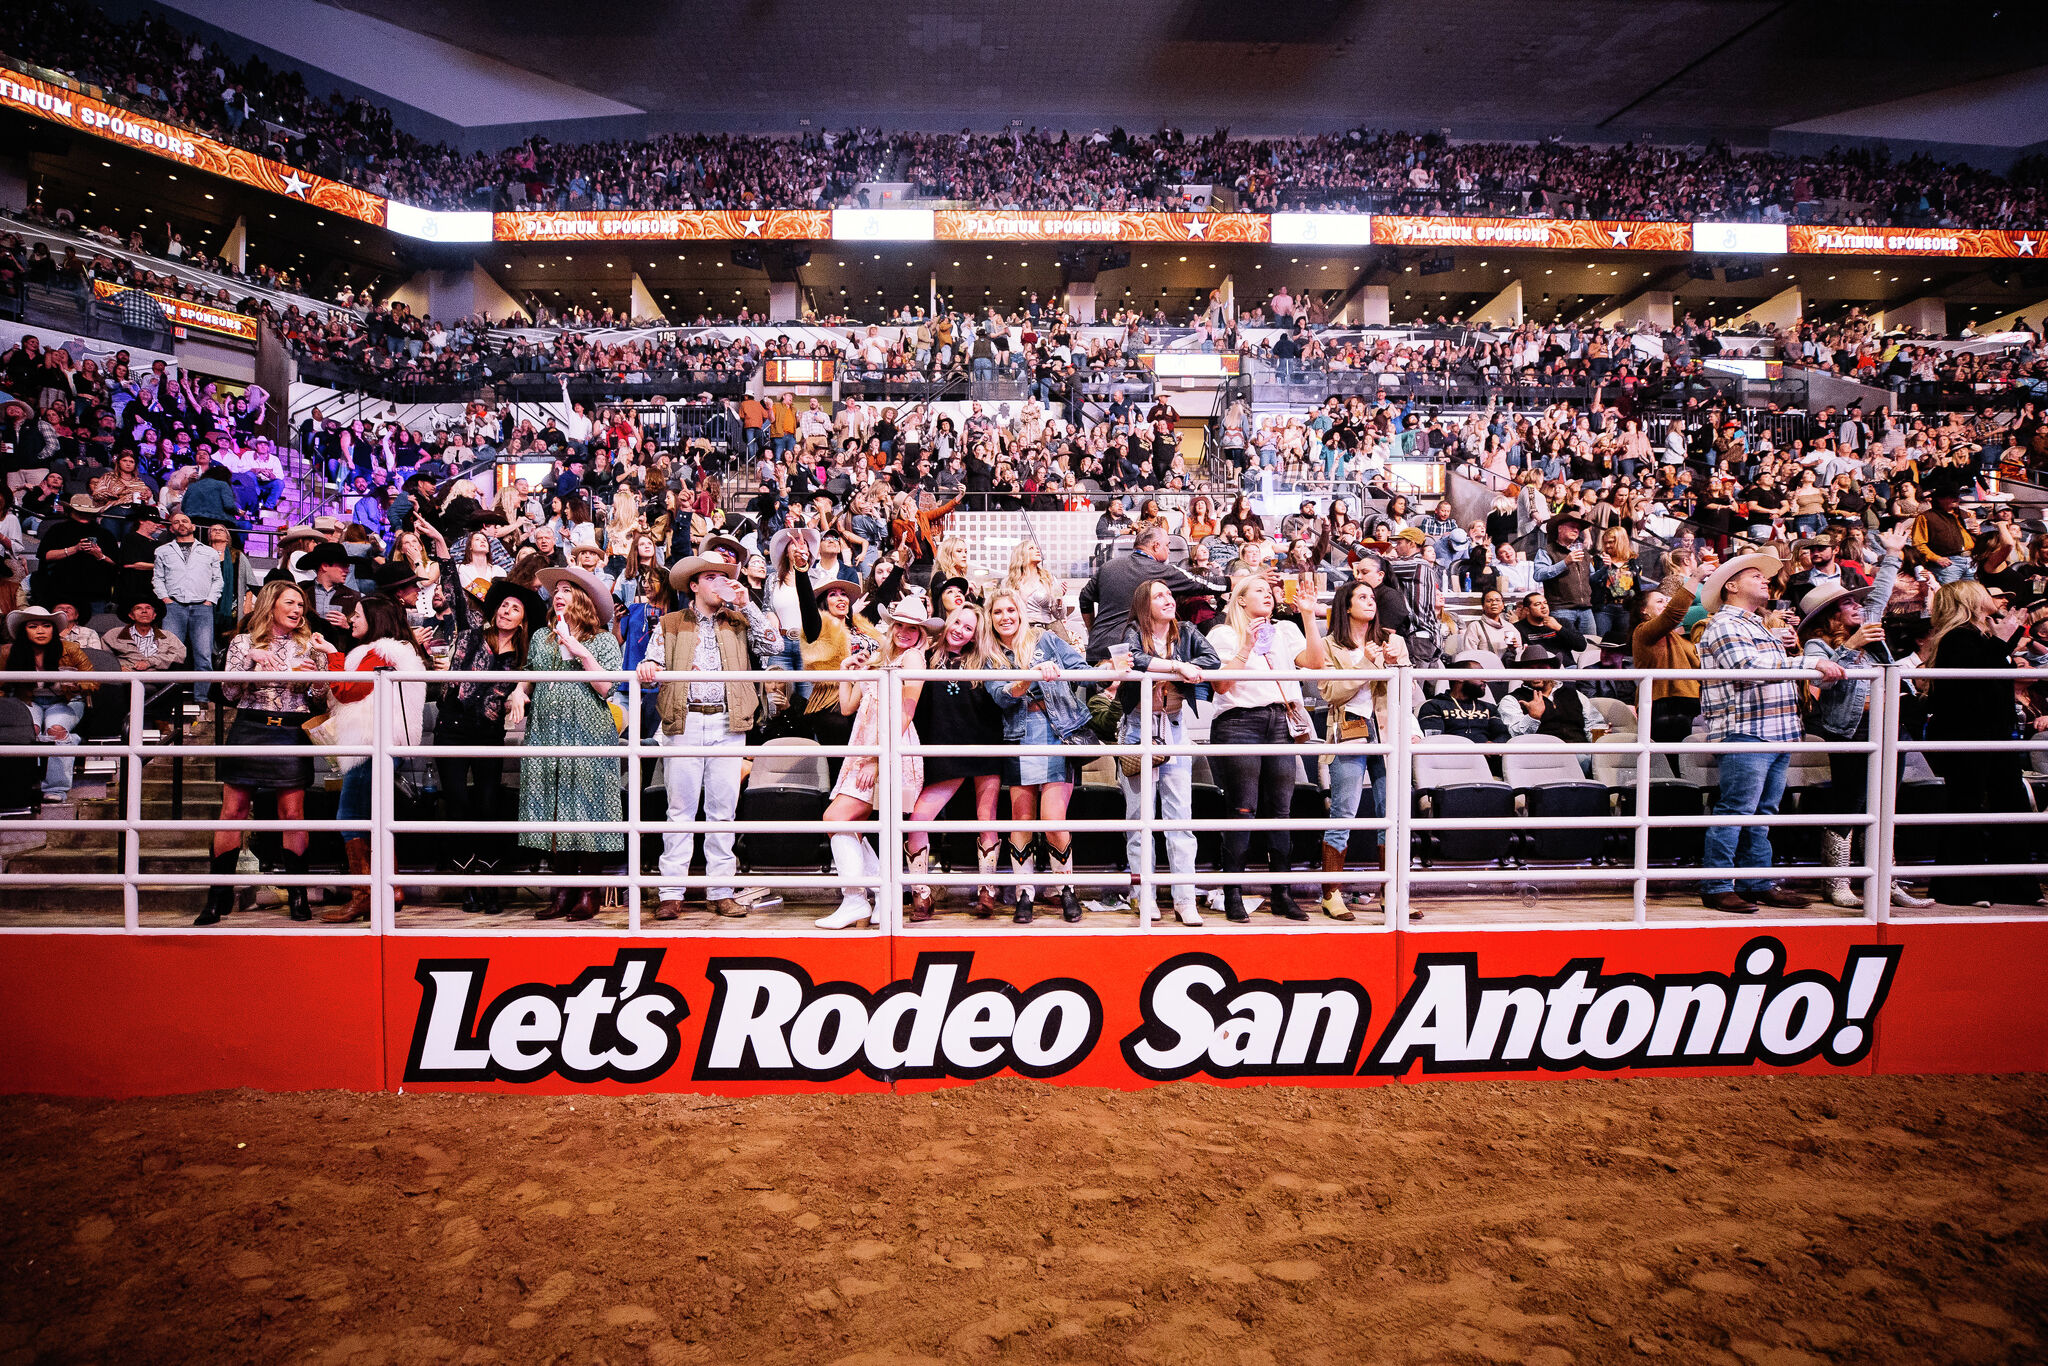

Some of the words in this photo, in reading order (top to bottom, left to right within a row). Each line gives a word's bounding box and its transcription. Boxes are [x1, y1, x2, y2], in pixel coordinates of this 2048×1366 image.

[81, 107, 195, 158] SPONSORS
[526, 220, 598, 234] PLATINUM
[603, 219, 679, 234] SPONSORS
[967, 219, 1040, 234] PLATINUM
[1044, 220, 1121, 234] SPONSORS
[1402, 225, 1472, 239] PLATINUM
[1476, 227, 1550, 241] SPONSORS
[1817, 234, 1884, 249] PLATINUM
[1888, 236, 1958, 250] SPONSORS
[180, 307, 242, 330] SPONSORS
[657, 331, 676, 342] 105
[414, 957, 680, 1075] Let's
[704, 960, 1094, 1071] Rodeo
[1130, 962, 1363, 1073] San
[1375, 944, 1890, 1064] Antonio!
